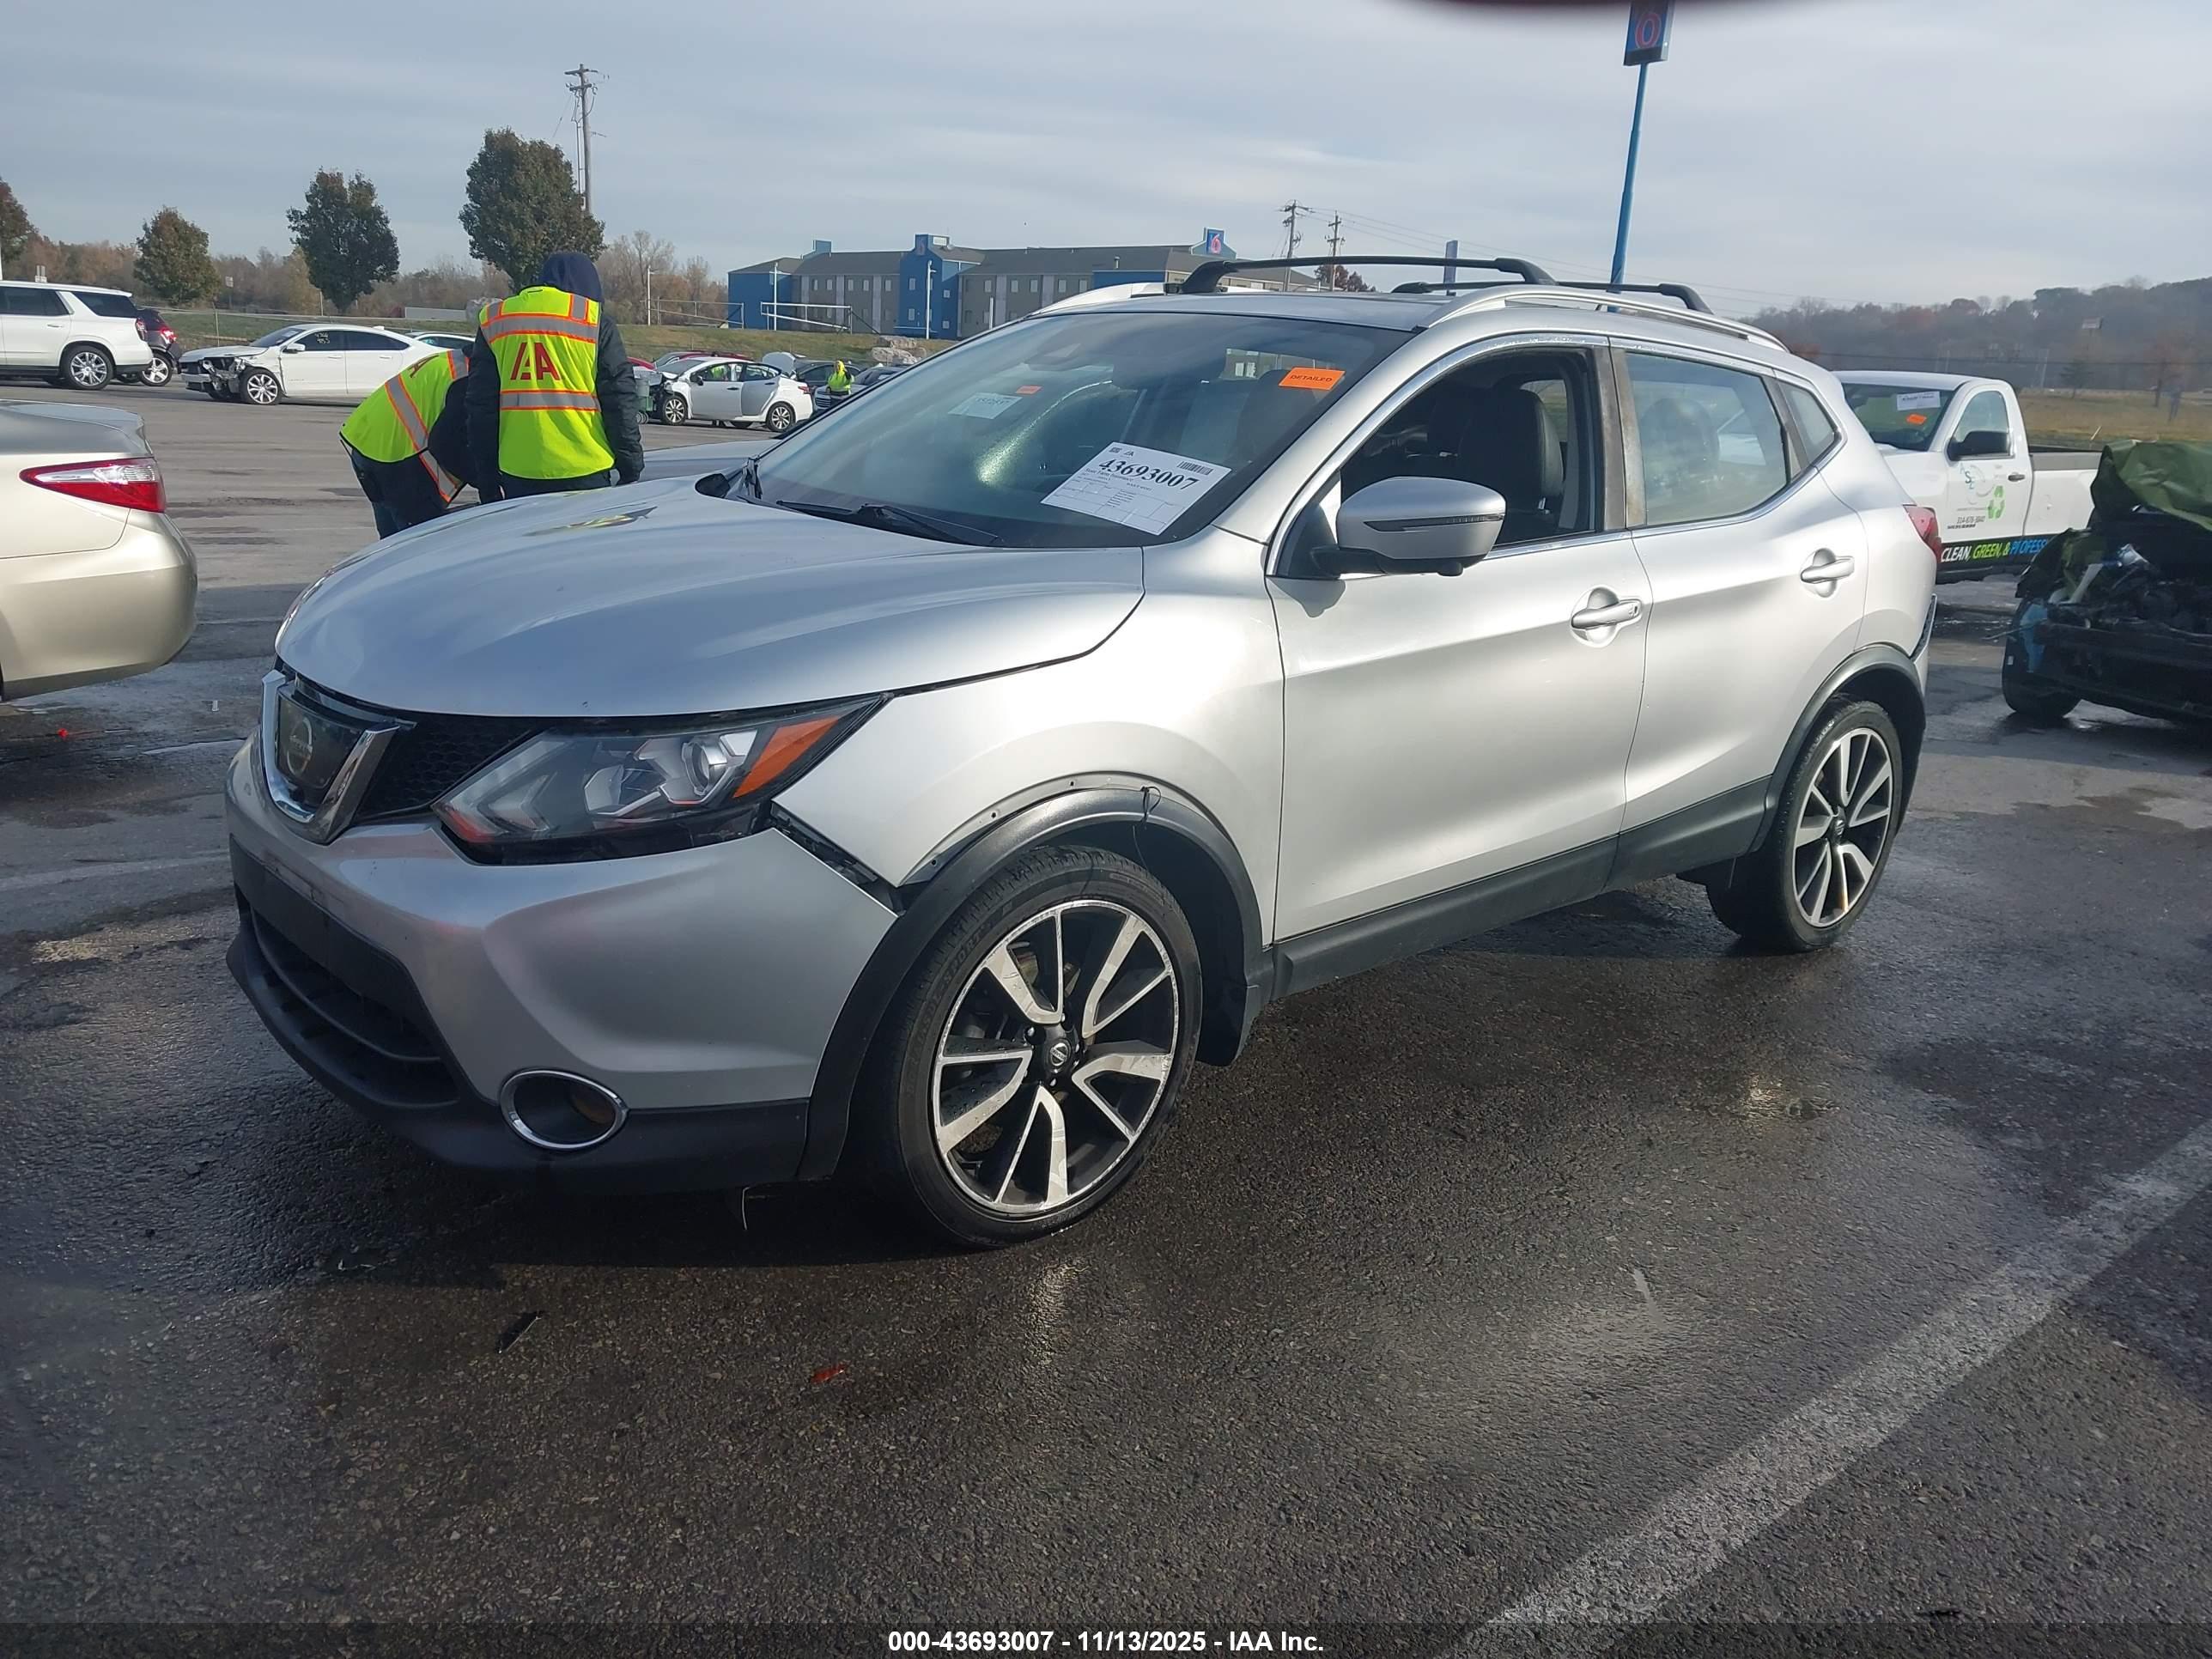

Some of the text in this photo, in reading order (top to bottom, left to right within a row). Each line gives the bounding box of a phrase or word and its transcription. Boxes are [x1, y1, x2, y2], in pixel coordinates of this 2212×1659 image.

[1099, 459, 1200, 490] 43693007
[1941, 545, 1972, 562] CLEAN,
[1972, 543, 2003, 559] GREEN,
[2002, 542, 2010, 556] &
